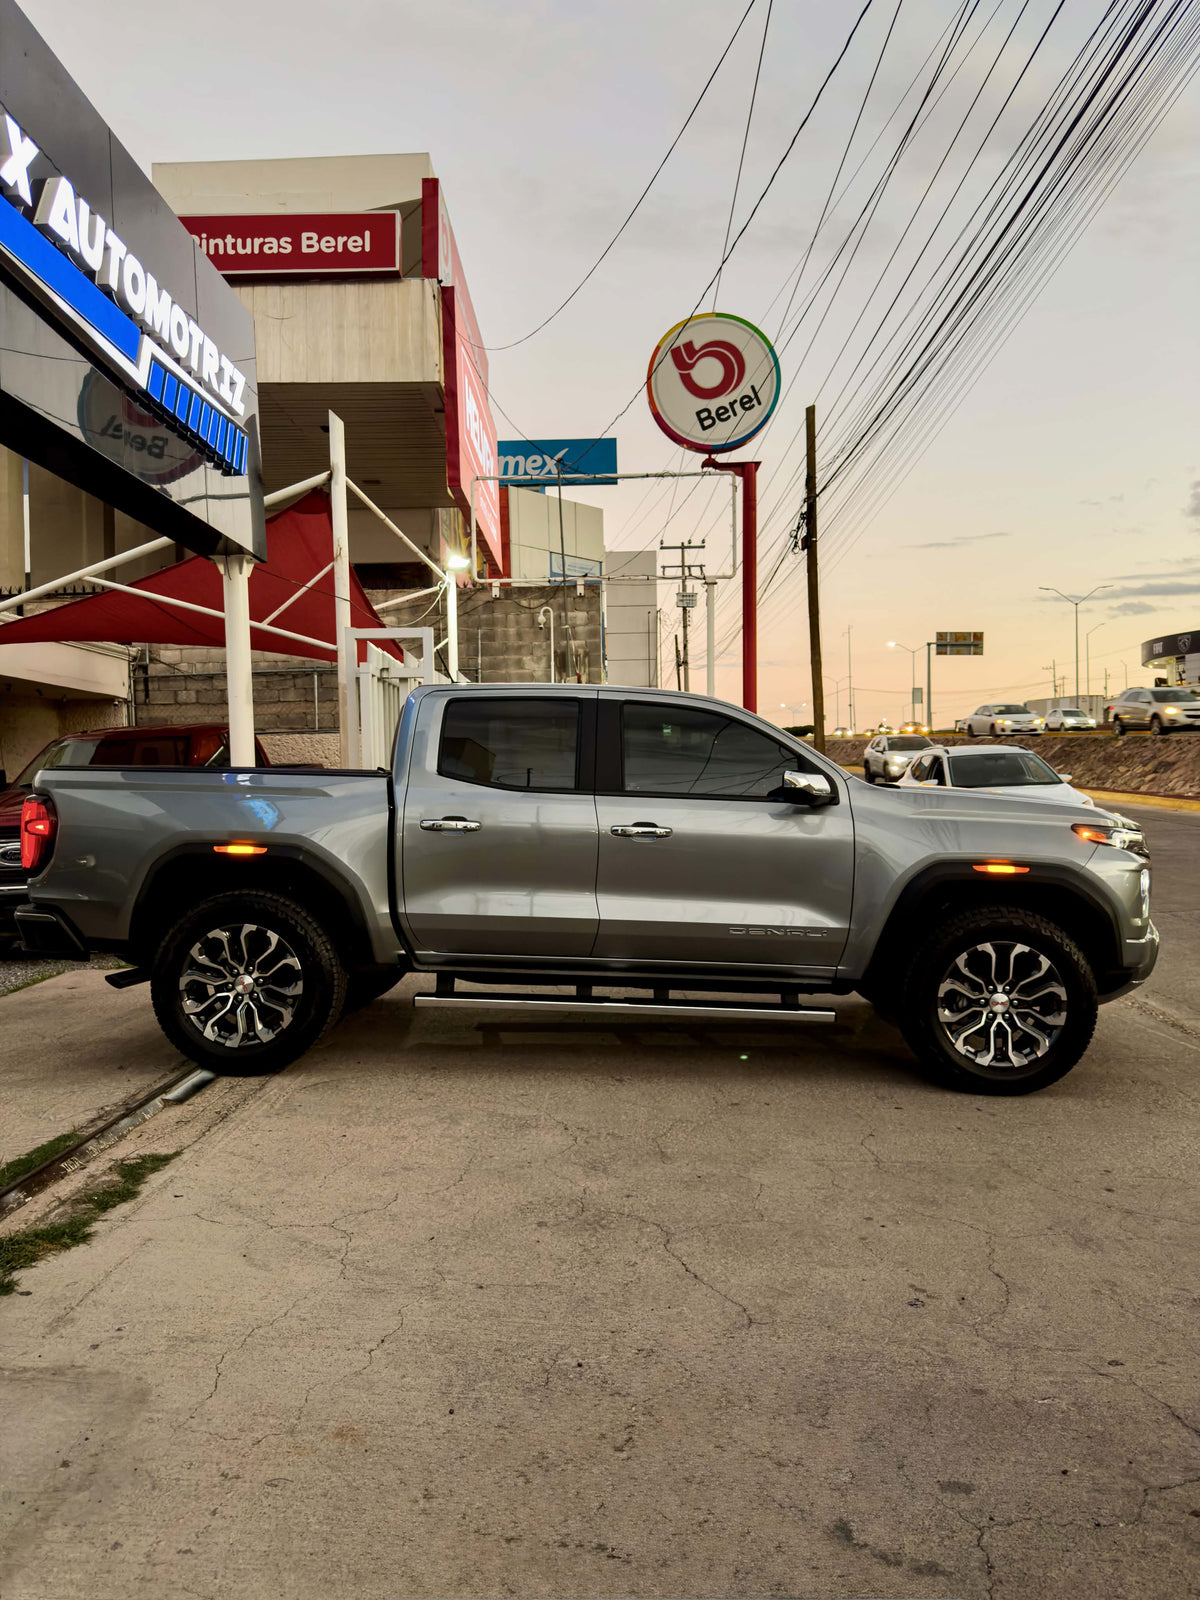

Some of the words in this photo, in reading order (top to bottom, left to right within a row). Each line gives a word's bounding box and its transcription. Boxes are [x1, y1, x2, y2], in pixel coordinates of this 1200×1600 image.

[301, 230, 371, 253] Berel
[0, 114, 39, 207] X
[47, 175, 246, 416] AUTOMOTRIZ
[695, 384, 762, 431] Berel
[729, 928, 828, 937] DENALI
